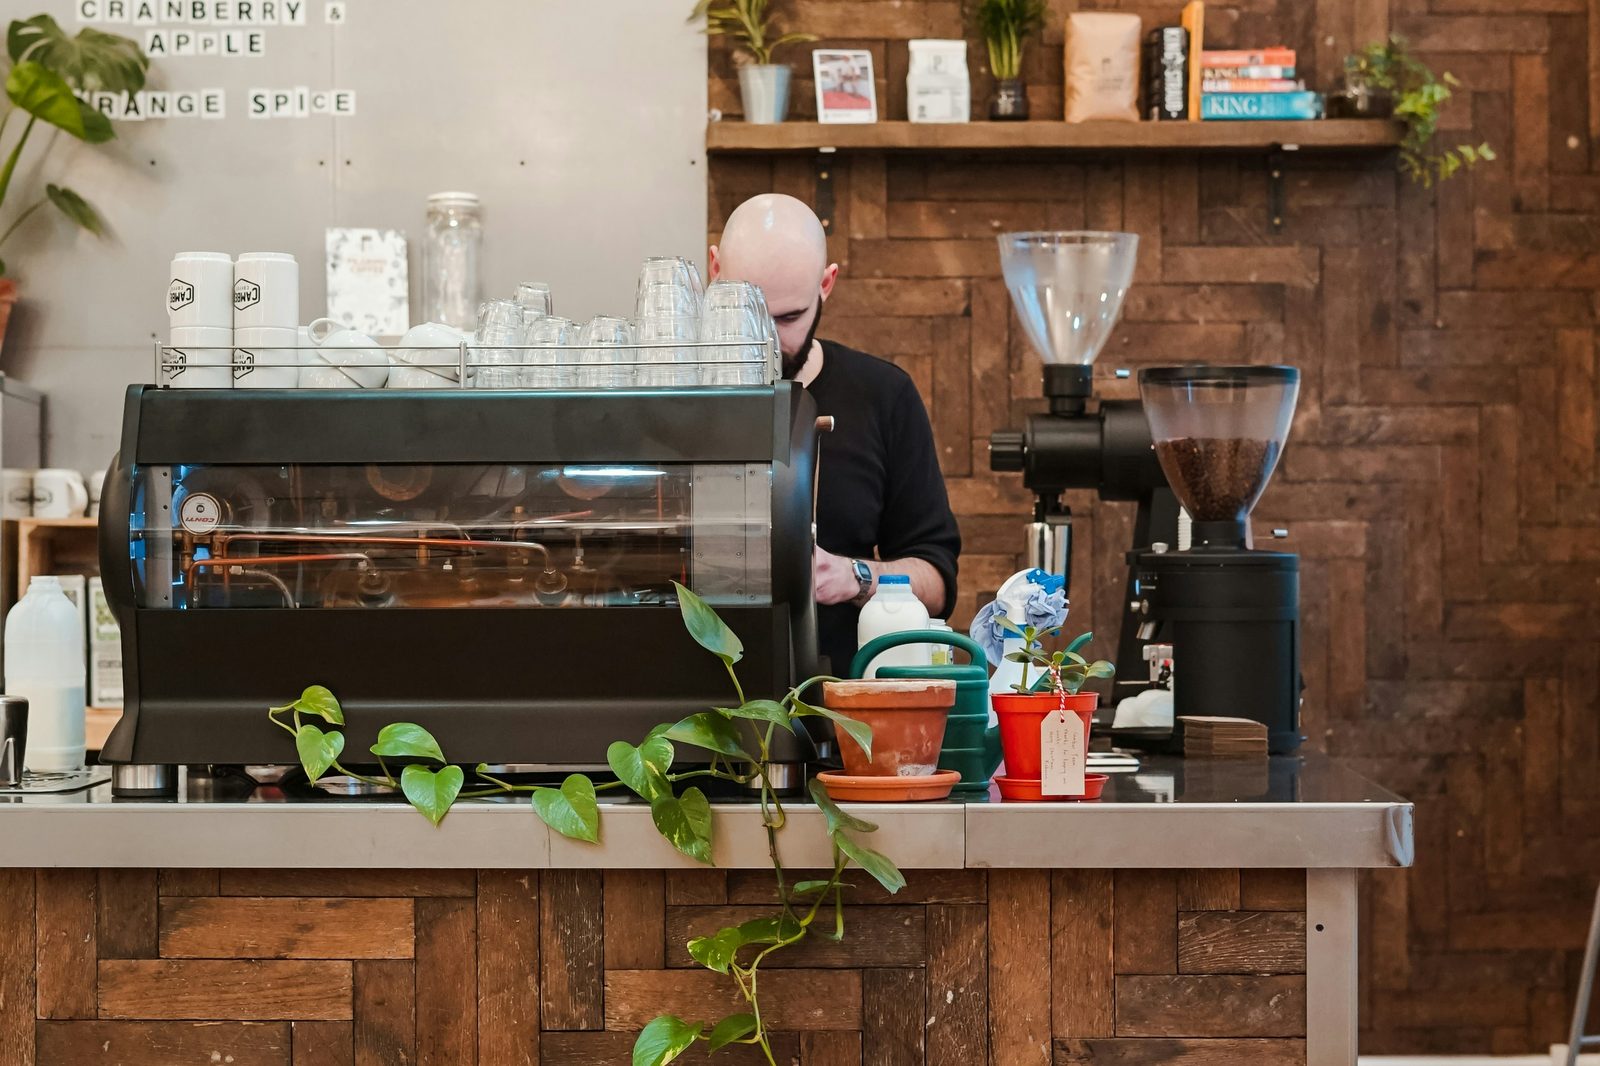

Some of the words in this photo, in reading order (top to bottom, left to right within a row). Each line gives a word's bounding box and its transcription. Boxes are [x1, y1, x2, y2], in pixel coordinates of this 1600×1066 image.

[80, 1, 302, 20] CRANBERRY
[329, 7, 340, 20] &
[149, 34, 262, 53] APPLE
[90, 95, 219, 115] RANGE
[253, 92, 350, 114] SPICE
[1211, 96, 1258, 115] KING
